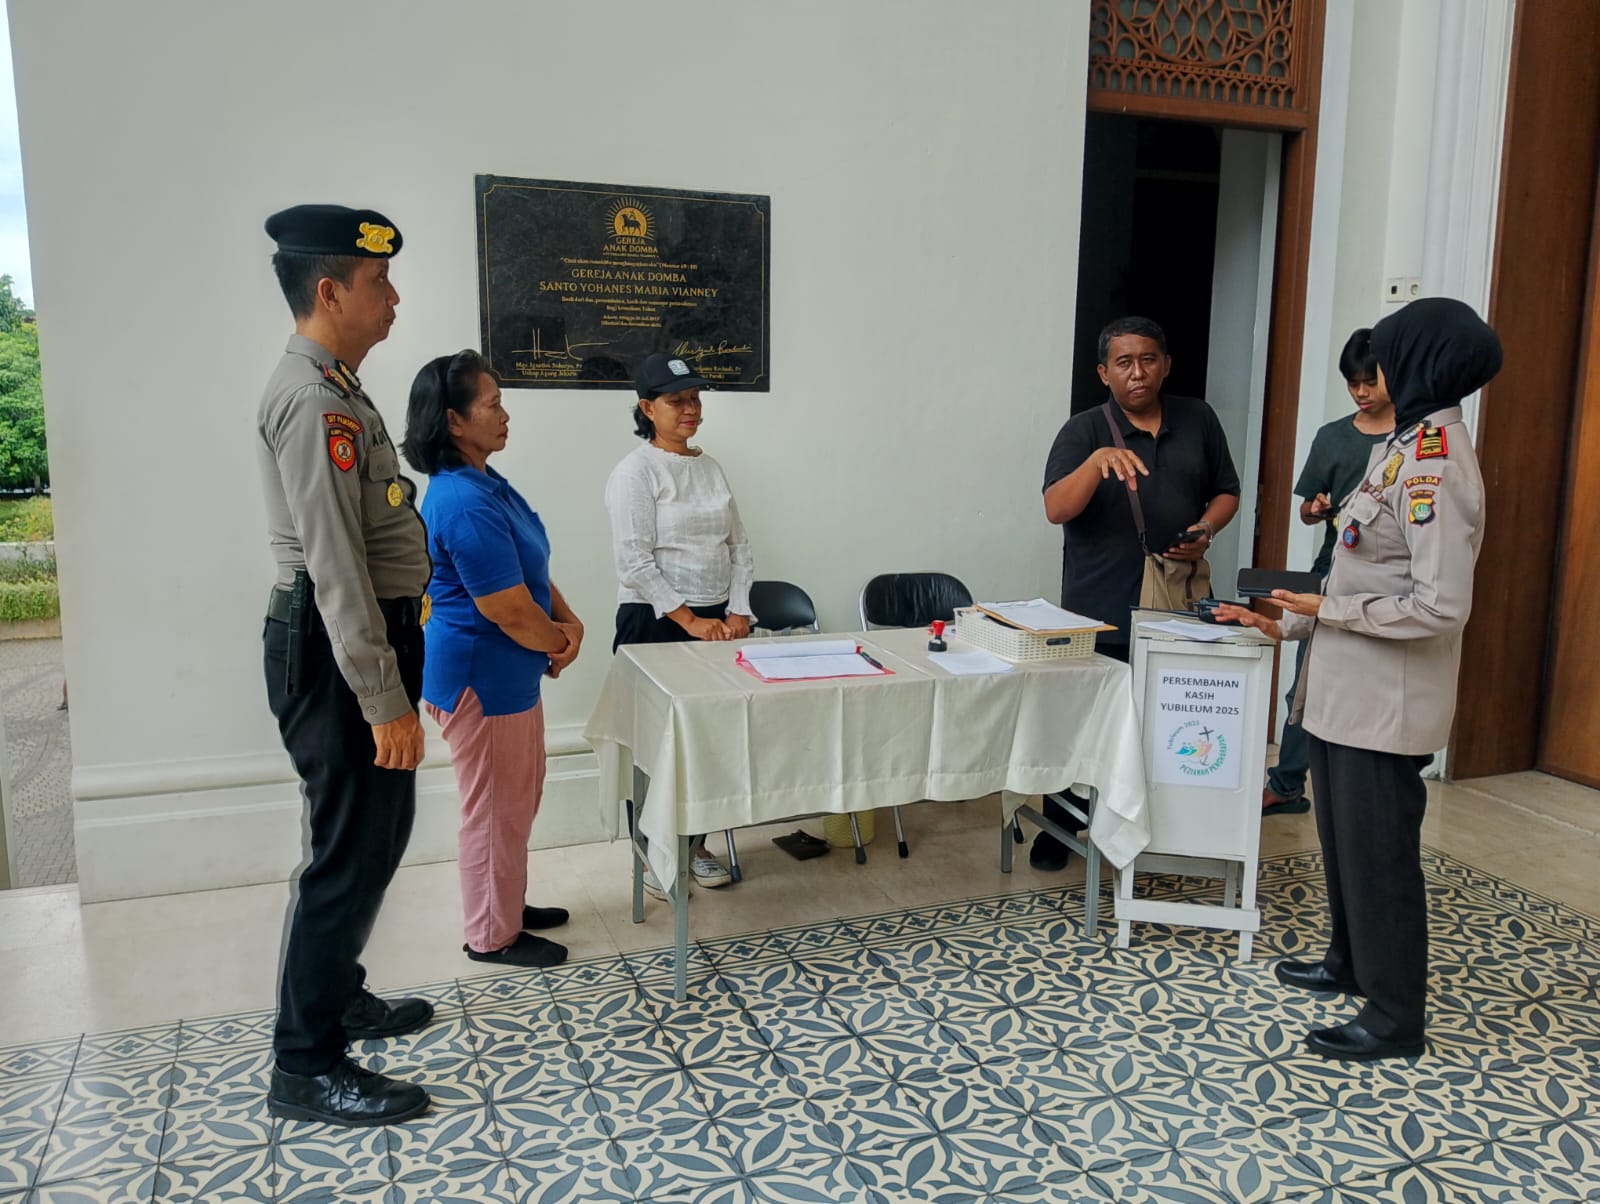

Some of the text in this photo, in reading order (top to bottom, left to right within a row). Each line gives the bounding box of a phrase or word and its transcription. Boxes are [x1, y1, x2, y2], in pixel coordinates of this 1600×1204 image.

[616, 237, 646, 245] GEREJA
[603, 244, 658, 254] ANAK DOMBA
[572, 268, 687, 283] GEREJA ANAK DOMBA
[539, 280, 719, 297] SANTO YOHANES MARIA VIANNEY
[1406, 476, 1438, 487] POLDA
[1163, 676, 1239, 688] PERSEMBAHAN
[1185, 691, 1214, 700] KASIH
[1160, 703, 1239, 715] YUBILEUM 2025
